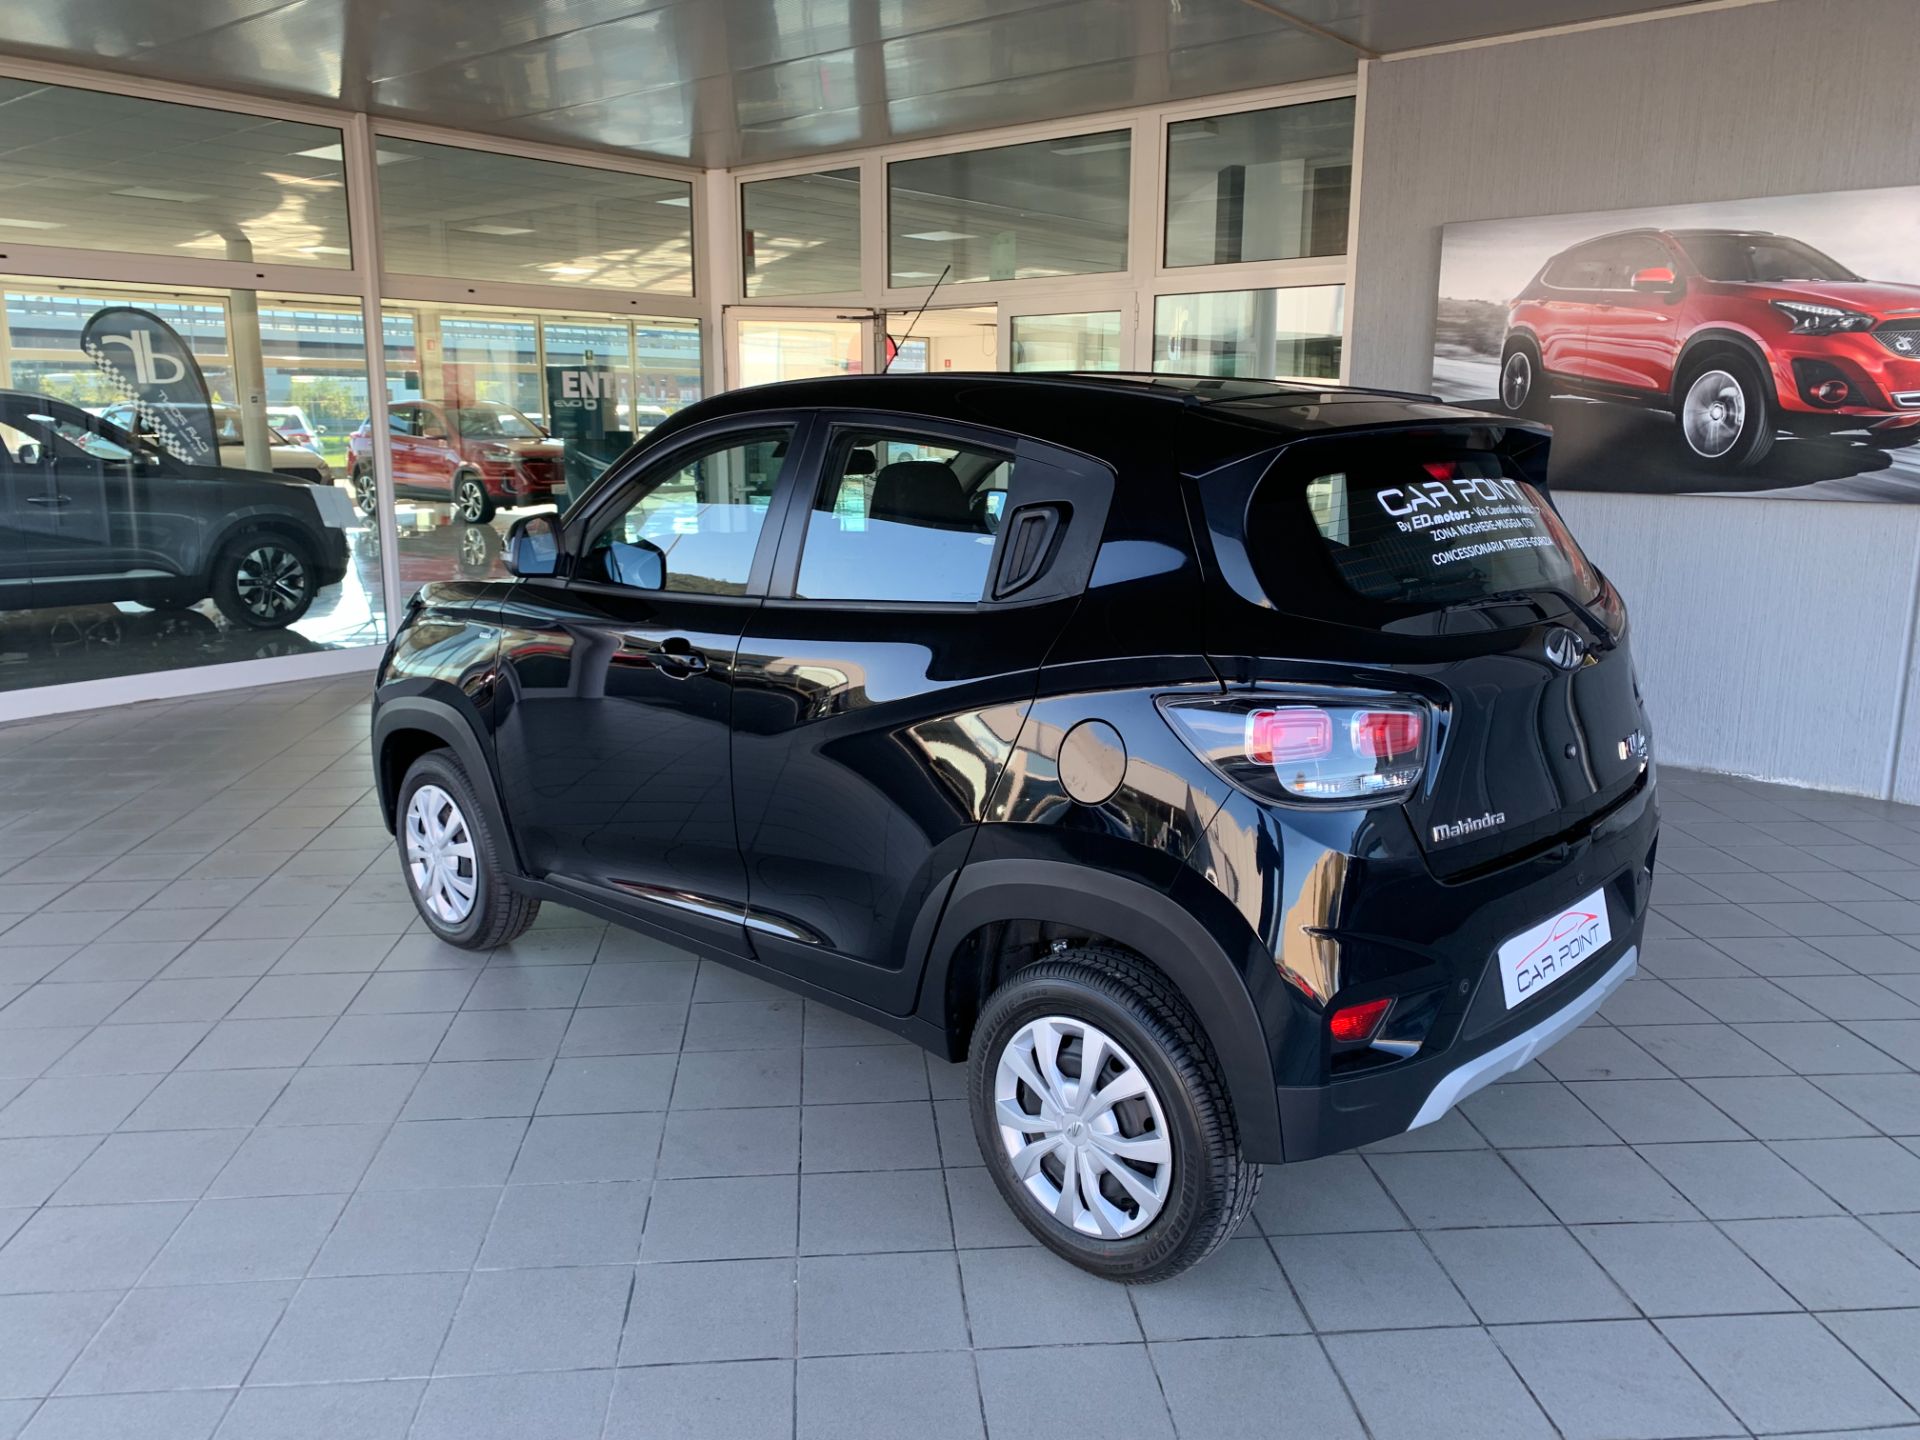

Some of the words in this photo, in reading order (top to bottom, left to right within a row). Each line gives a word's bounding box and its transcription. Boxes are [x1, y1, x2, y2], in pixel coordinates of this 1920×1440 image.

[1377, 481, 1458, 516] CAR
[1453, 478, 1524, 502] POINT
[1396, 521, 1412, 533] By
[1430, 526, 1459, 541] ZONA
[1432, 541, 1505, 566] CONCESSIONARIA
[1432, 811, 1506, 843] Mahindra
[1517, 954, 1555, 993] CAR
[1558, 923, 1599, 967] POINT
